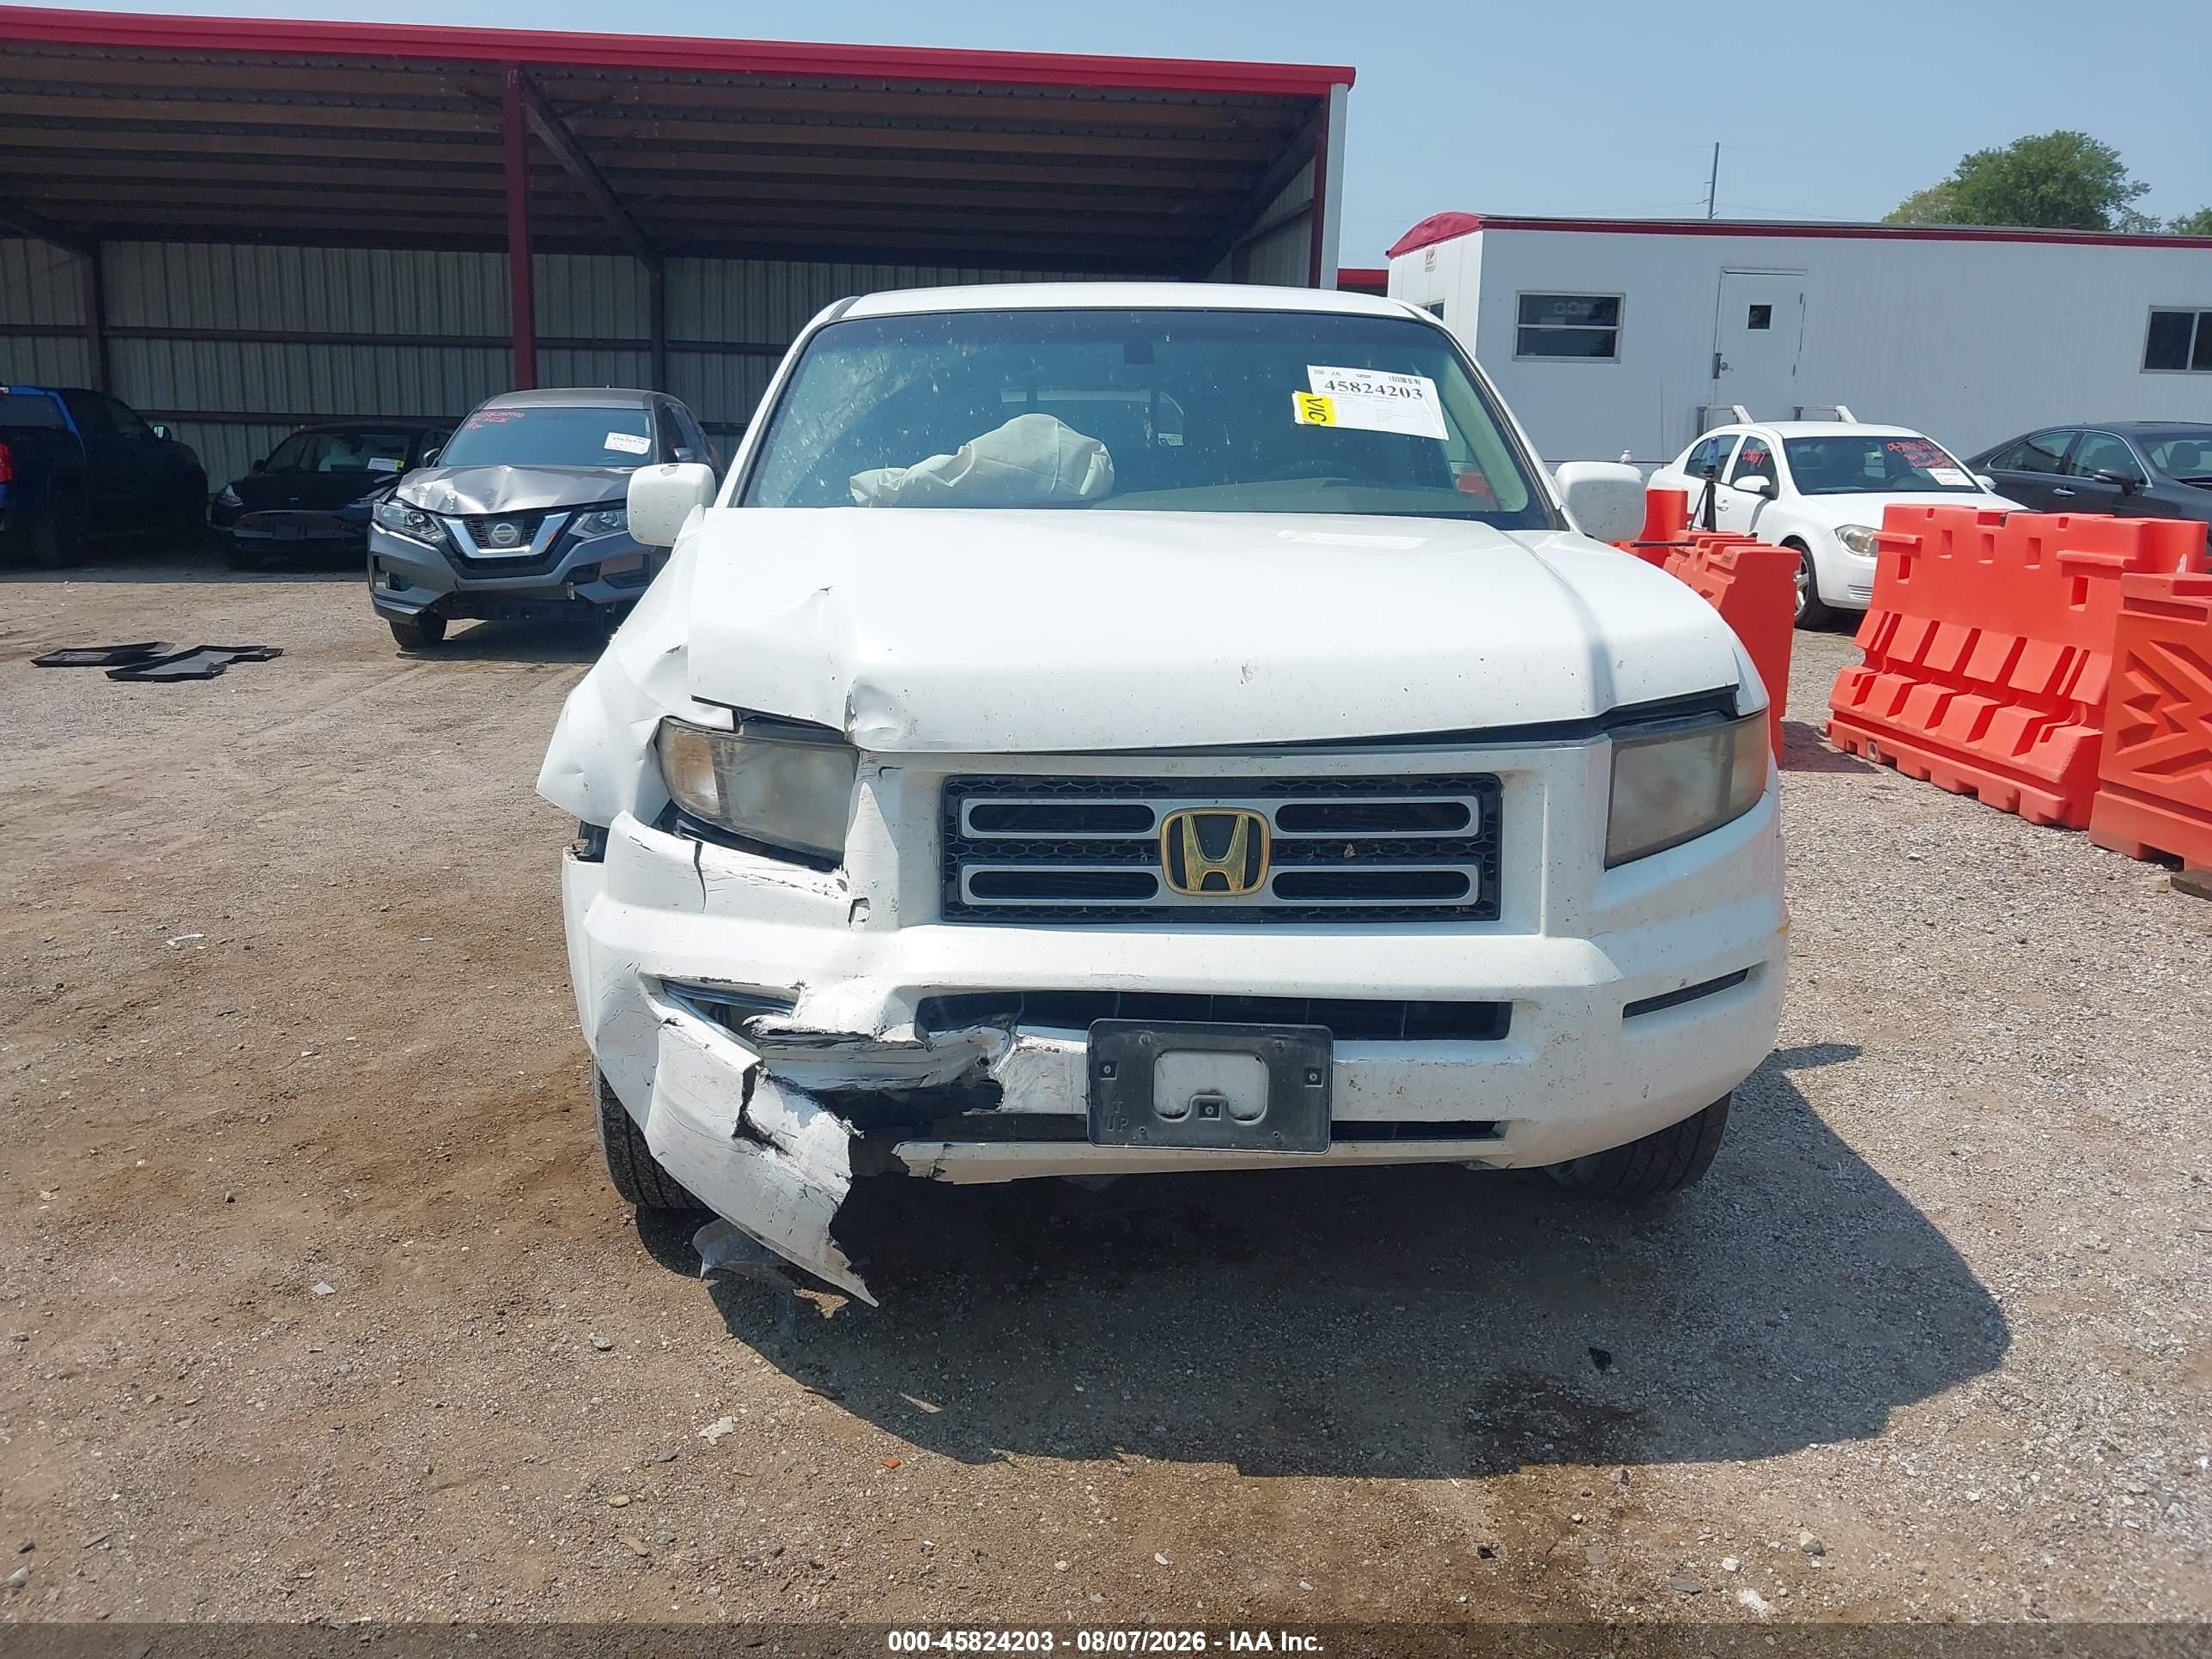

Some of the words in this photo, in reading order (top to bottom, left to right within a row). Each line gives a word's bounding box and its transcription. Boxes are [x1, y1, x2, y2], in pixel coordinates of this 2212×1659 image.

[1325, 380, 1423, 399] 45824203
[1305, 398, 1328, 422] VIC
[1105, 1115, 1129, 1133] UP
